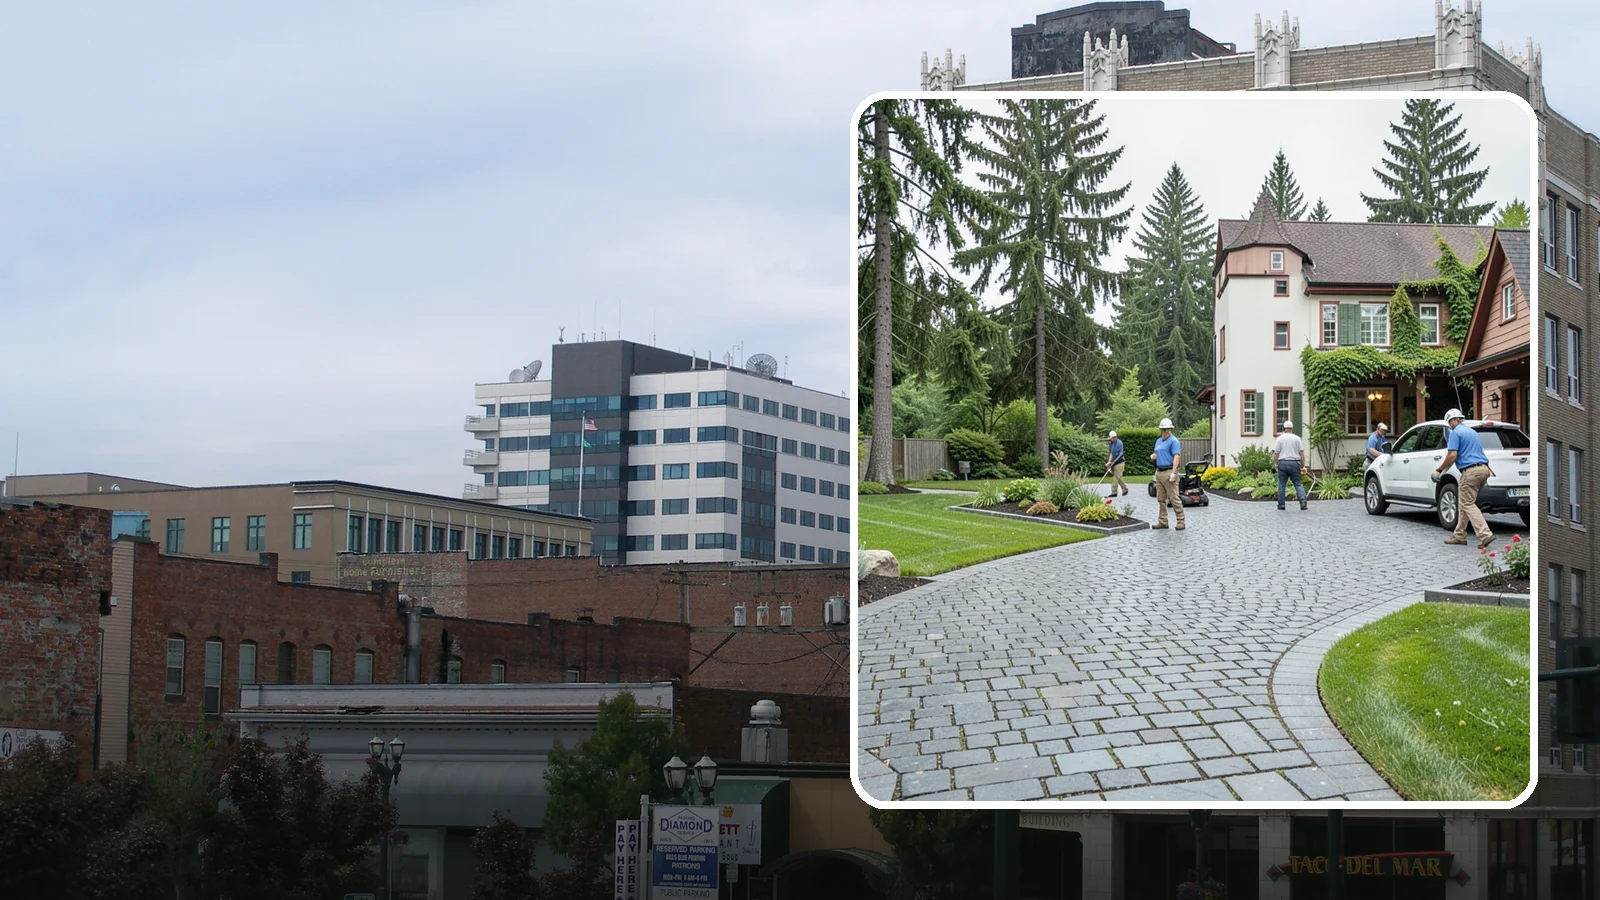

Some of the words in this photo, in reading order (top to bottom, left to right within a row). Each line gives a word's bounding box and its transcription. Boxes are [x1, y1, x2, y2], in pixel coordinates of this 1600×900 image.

[343, 568, 367, 577] Home
[370, 566, 427, 577] Furnishers
[660, 818, 713, 832] DIAMOND
[1022, 815, 1070, 828] BUILDING
[617, 824, 625, 852] PAY
[628, 824, 637, 852] PAY
[656, 845, 688, 853] RESERVED
[689, 846, 716, 854] PARKING
[721, 851, 739, 862] Soup
[671, 862, 701, 870] PATRONS
[1344, 856, 1385, 876] DEL
[1392, 857, 1442, 877] MAR
[616, 855, 625, 894] HERE
[627, 855, 636, 894] HERE
[660, 888, 681, 897] PUBLIC
[683, 889, 710, 898] PARKING
